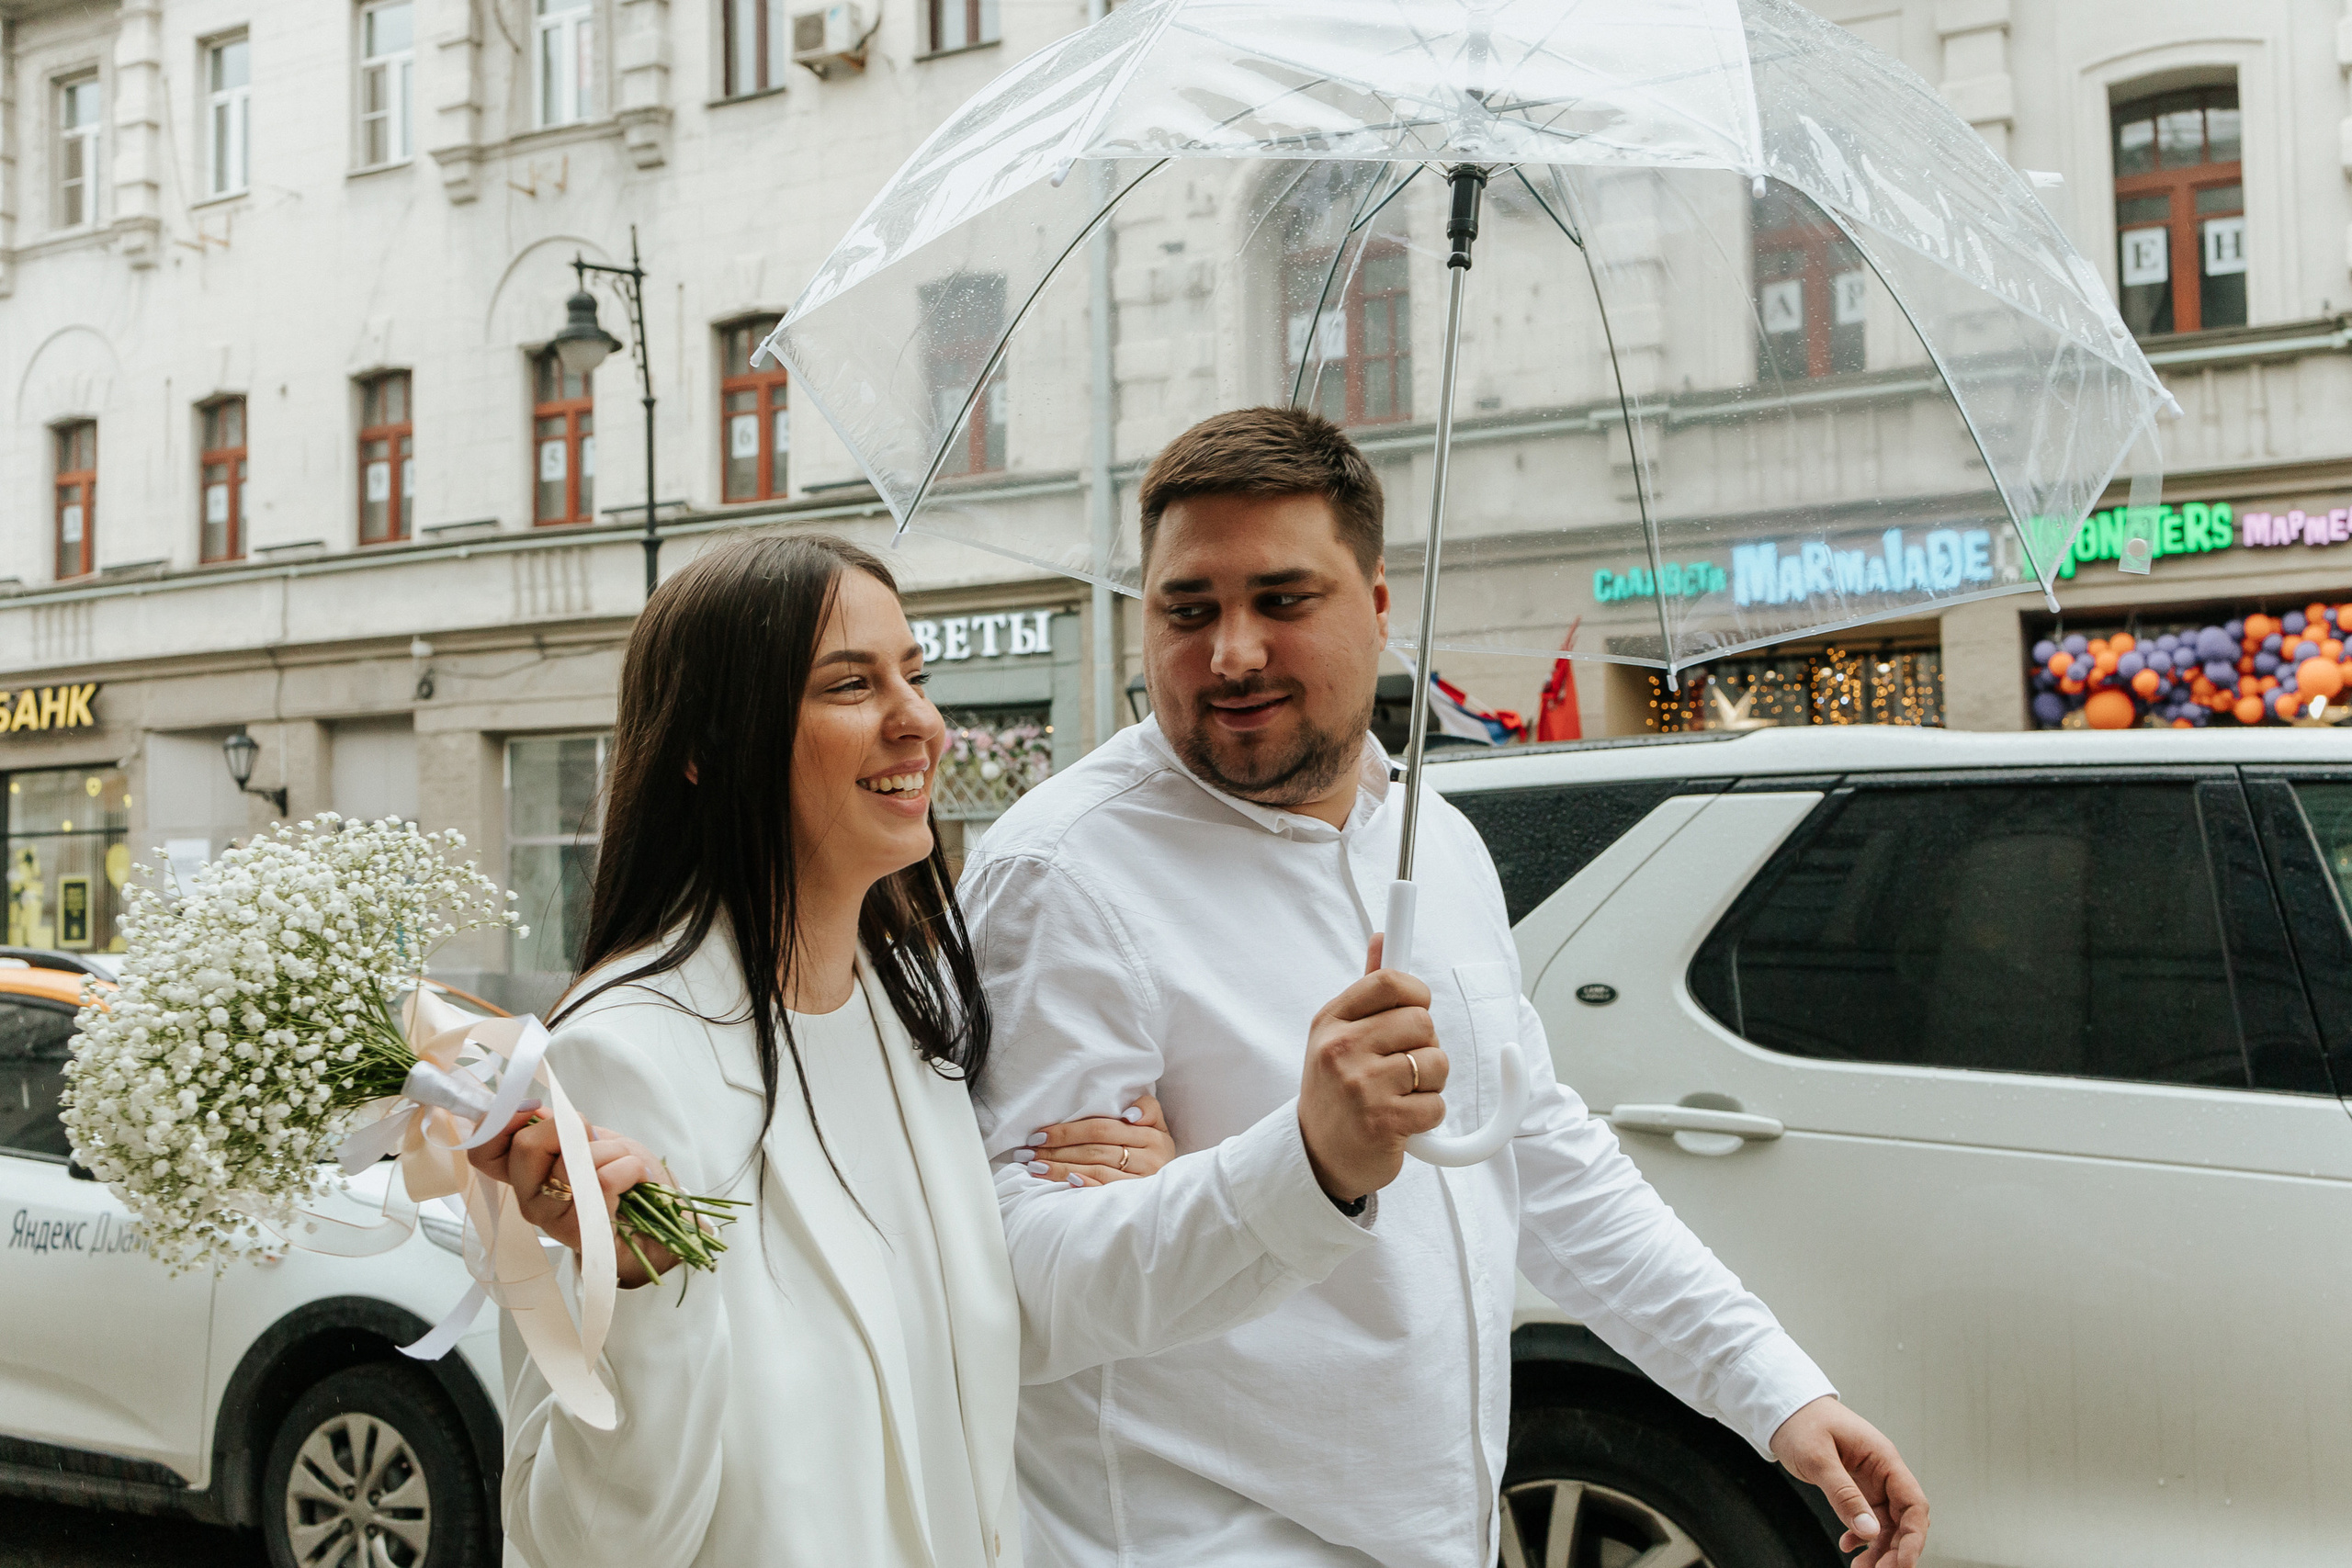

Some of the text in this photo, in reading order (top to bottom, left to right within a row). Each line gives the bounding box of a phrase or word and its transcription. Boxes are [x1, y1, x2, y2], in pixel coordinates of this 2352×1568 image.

[2132, 240, 2158, 269] Е
[2242, 504, 2352, 547] МАРМЕ
[8, 1207, 87, 1255] Яндекс
